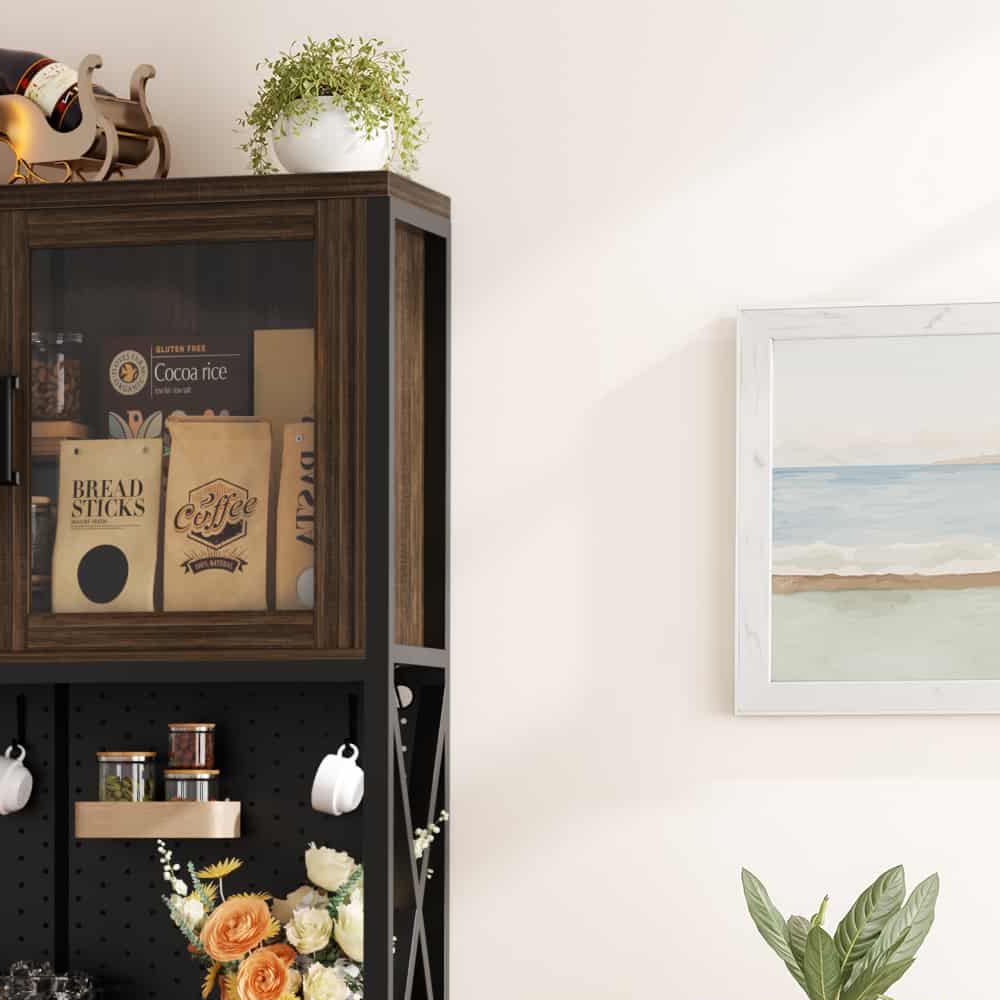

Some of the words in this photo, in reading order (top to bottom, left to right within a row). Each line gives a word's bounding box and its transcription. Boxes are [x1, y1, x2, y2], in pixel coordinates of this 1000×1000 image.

[155, 345, 185, 353] GLUTEN
[187, 344, 207, 352] FREE
[154, 362, 198, 382] Cocoa
[202, 361, 228, 381] rice
[72, 479, 144, 498] BREAD
[72, 499, 145, 517] STICKS
[174, 493, 258, 530] Coffee
